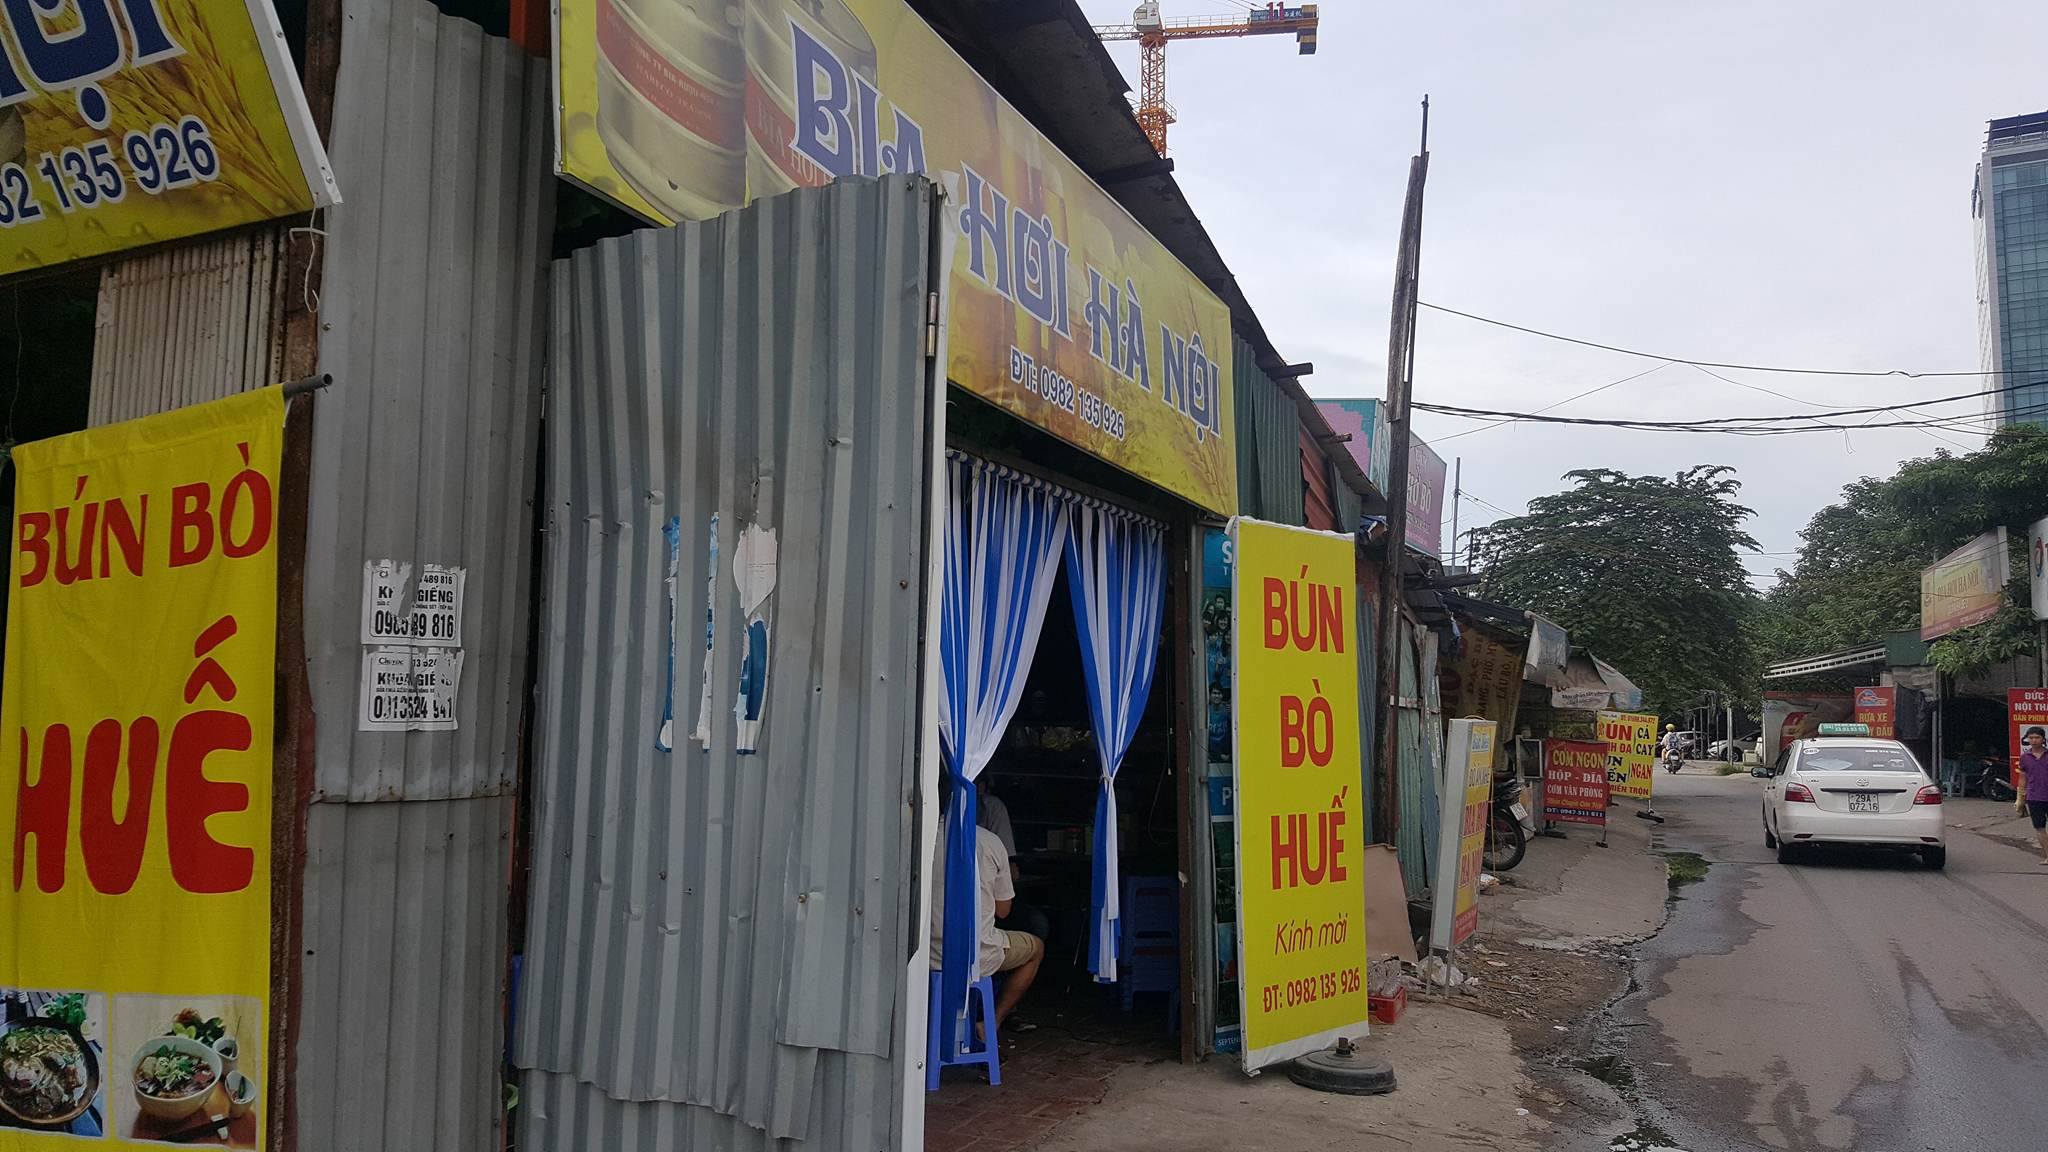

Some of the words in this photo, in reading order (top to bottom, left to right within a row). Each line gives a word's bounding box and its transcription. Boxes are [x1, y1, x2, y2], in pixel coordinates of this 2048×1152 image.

[40, 143, 122, 208] 135
[126, 118, 217, 190] 926
[960, 160, 1073, 342] HƠI
[1084, 264, 1152, 392] HÀ
[1160, 320, 1221, 443] NỘI
[1010, 345, 1038, 393] ĐT:
[1041, 366, 1075, 414] 0982
[1078, 388, 1101, 428] 135
[1103, 403, 1125, 441] 926
[19, 475, 149, 588] BÚN
[168, 441, 272, 568] BÒ
[418, 585, 454, 603] GIẾNG
[432, 613, 454, 638] 816
[1264, 565, 1345, 654] BÚN
[1280, 678, 1333, 768] BÒ
[1636, 743, 1653, 755] CAY
[1877, 713, 1888, 722] XE
[13, 614, 254, 895] HUẾ
[1577, 751, 1605, 769] NGON
[1855, 794, 1871, 803] 29A
[1270, 785, 1349, 890] HUẾ
[1275, 919, 1313, 955] Kính
[1318, 912, 1349, 948] mời
[1263, 984, 1283, 1013] ĐT:
[1287, 976, 1317, 1007] 0982
[1320, 972, 1337, 999] 135
[1341, 967, 1361, 995] 926
